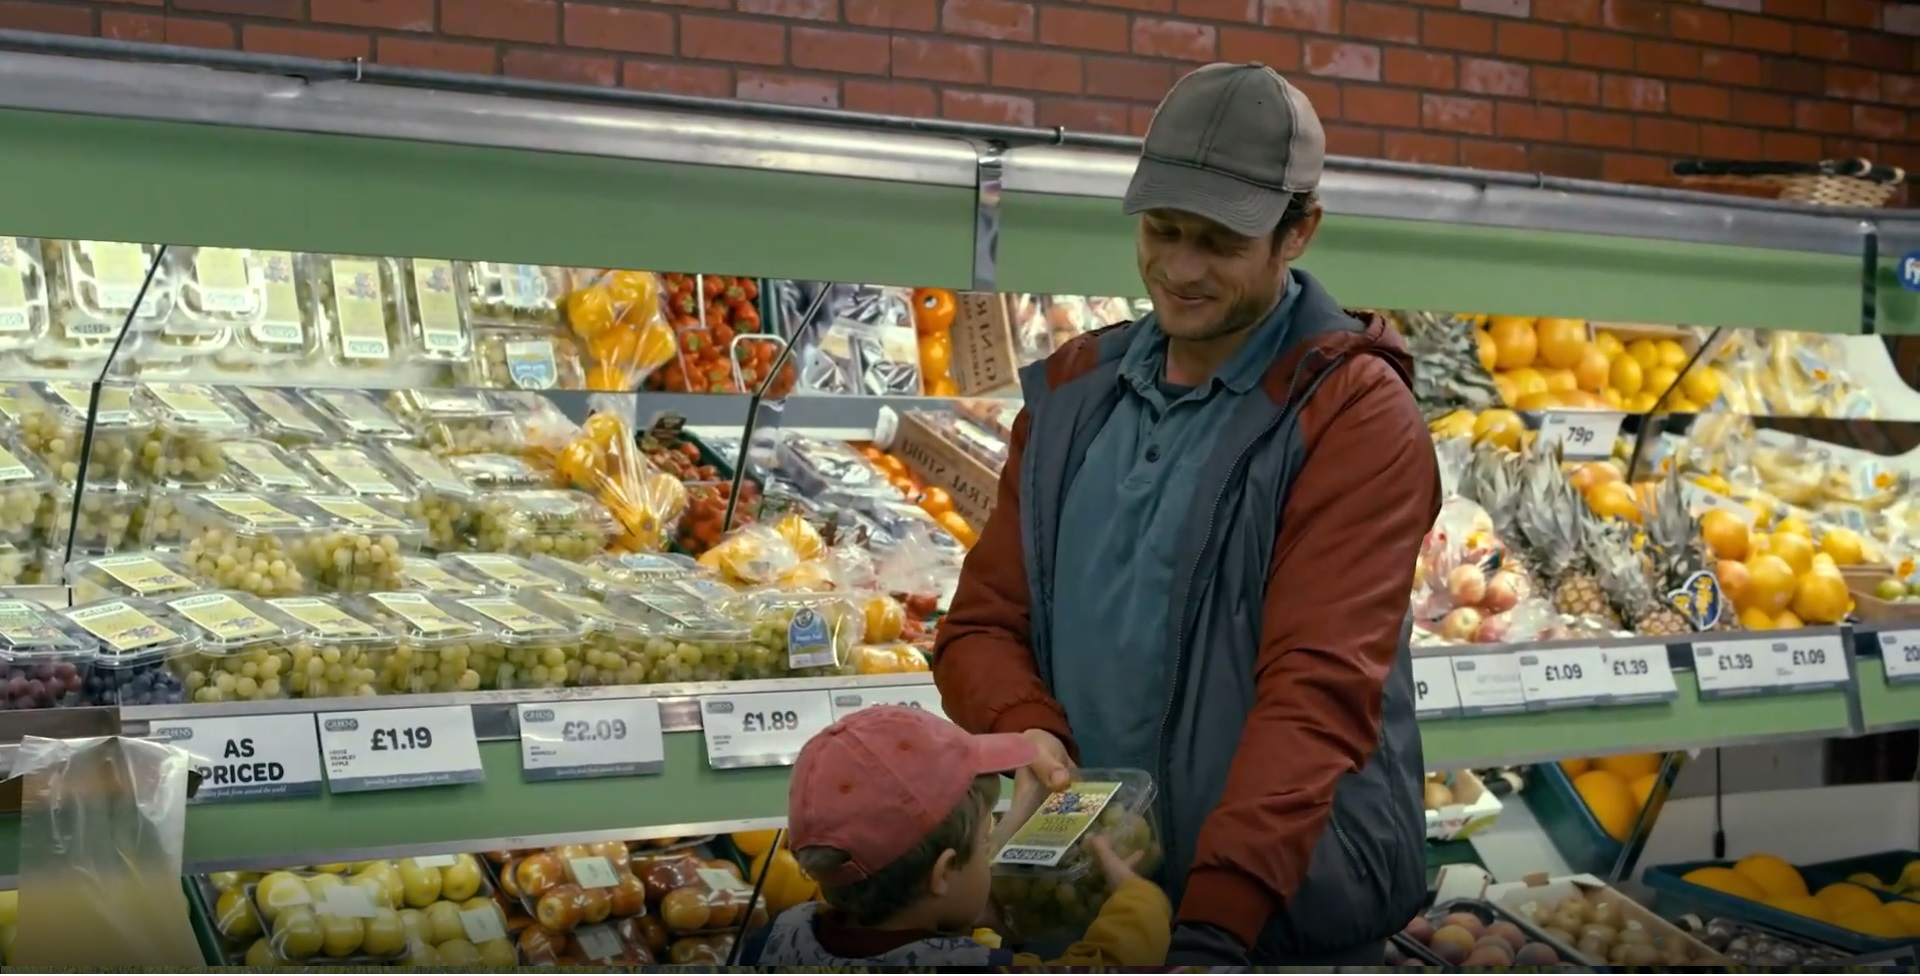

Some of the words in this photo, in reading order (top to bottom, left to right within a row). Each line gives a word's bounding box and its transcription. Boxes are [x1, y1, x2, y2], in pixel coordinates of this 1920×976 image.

[1905, 257, 1920, 285] fy
[1566, 426, 1595, 447] 79p
[1718, 654, 1753, 671] £1.39
[1792, 649, 1826, 666] £1.09
[1903, 645, 1920, 663] 20
[1545, 664, 1583, 681] £1.09
[1613, 660, 1648, 676] £1.39
[1416, 681, 1429, 700] p
[562, 719, 627, 741] £2.09
[742, 710, 798, 732] £1.89
[224, 738, 255, 758] AS
[371, 726, 432, 750] £1.19
[198, 762, 285, 785] PRICED
